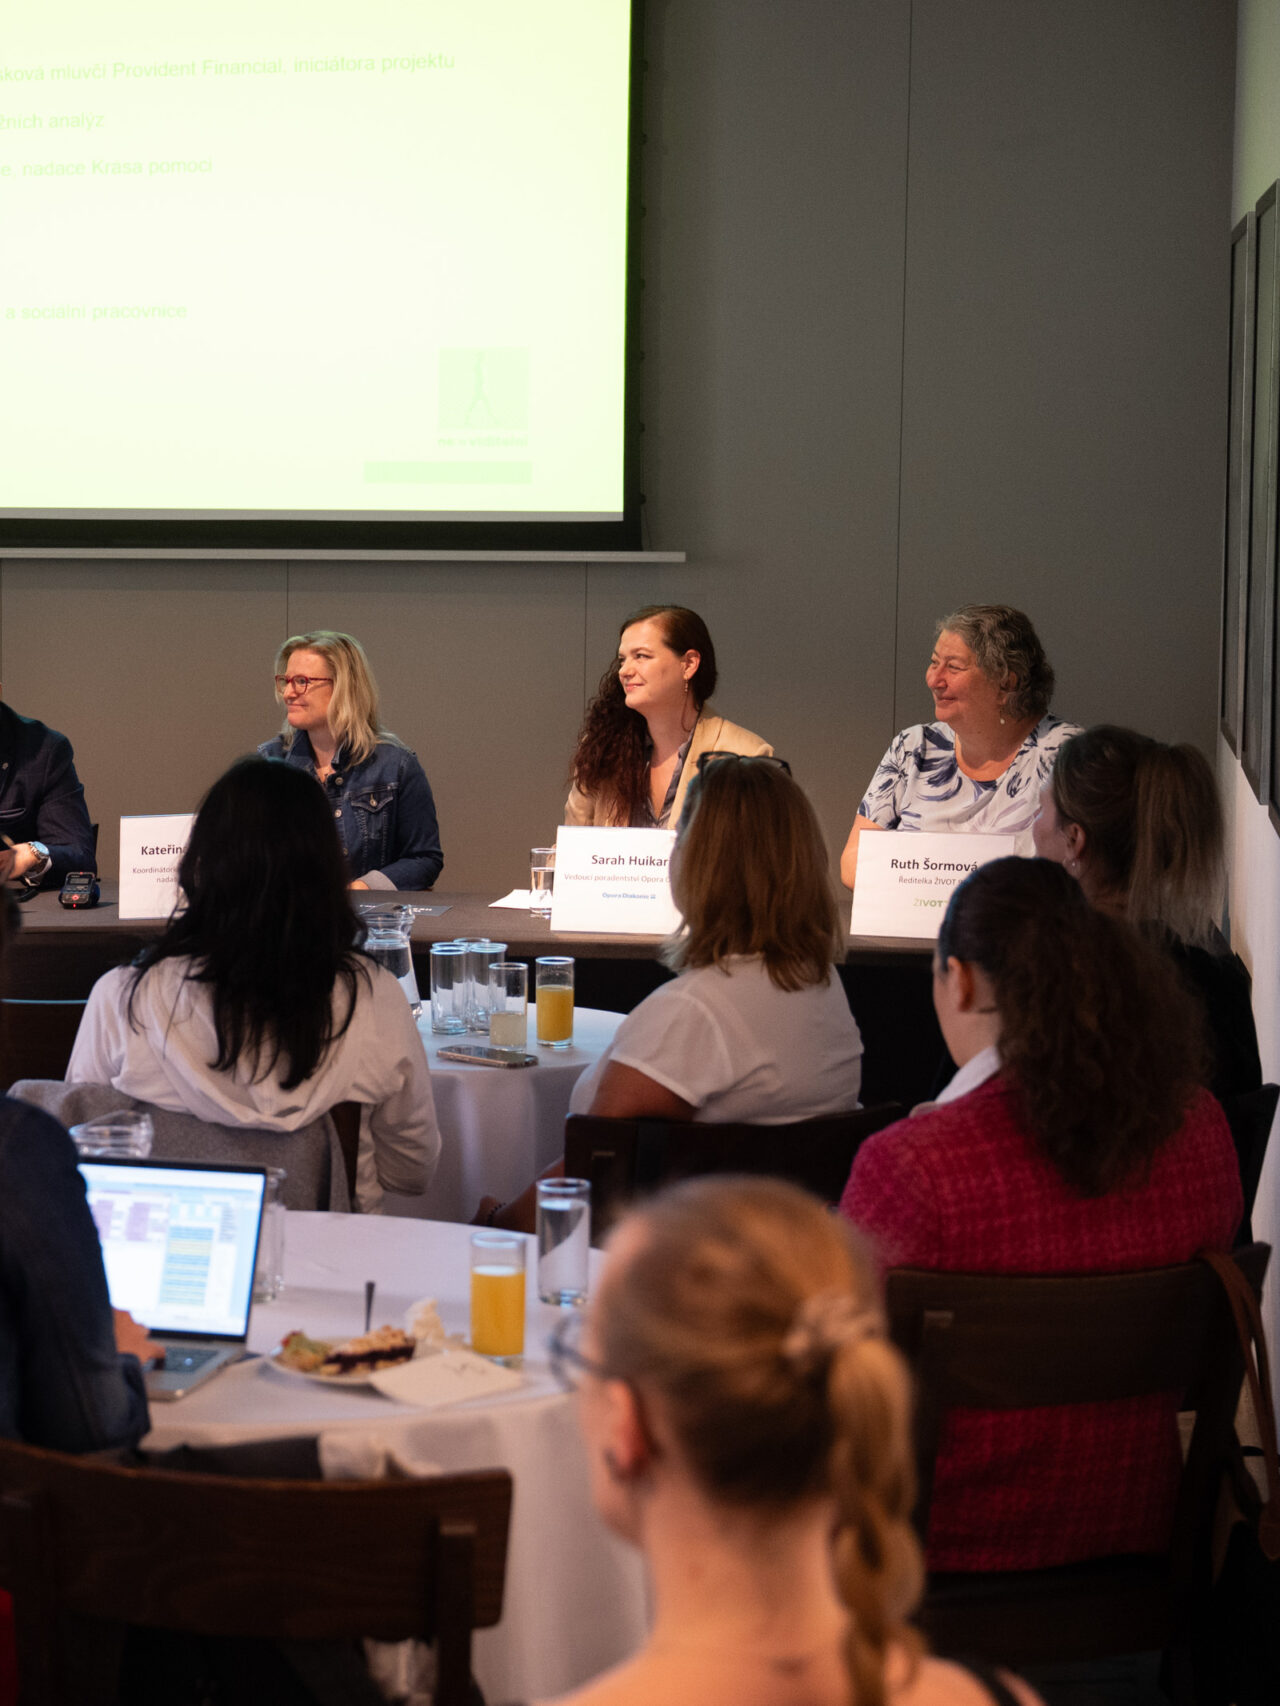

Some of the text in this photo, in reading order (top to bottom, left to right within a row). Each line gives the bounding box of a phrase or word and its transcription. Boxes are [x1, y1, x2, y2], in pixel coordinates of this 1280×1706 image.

[591, 854, 669, 867] Sarah Huikar
[890, 858, 920, 870] Ruth
